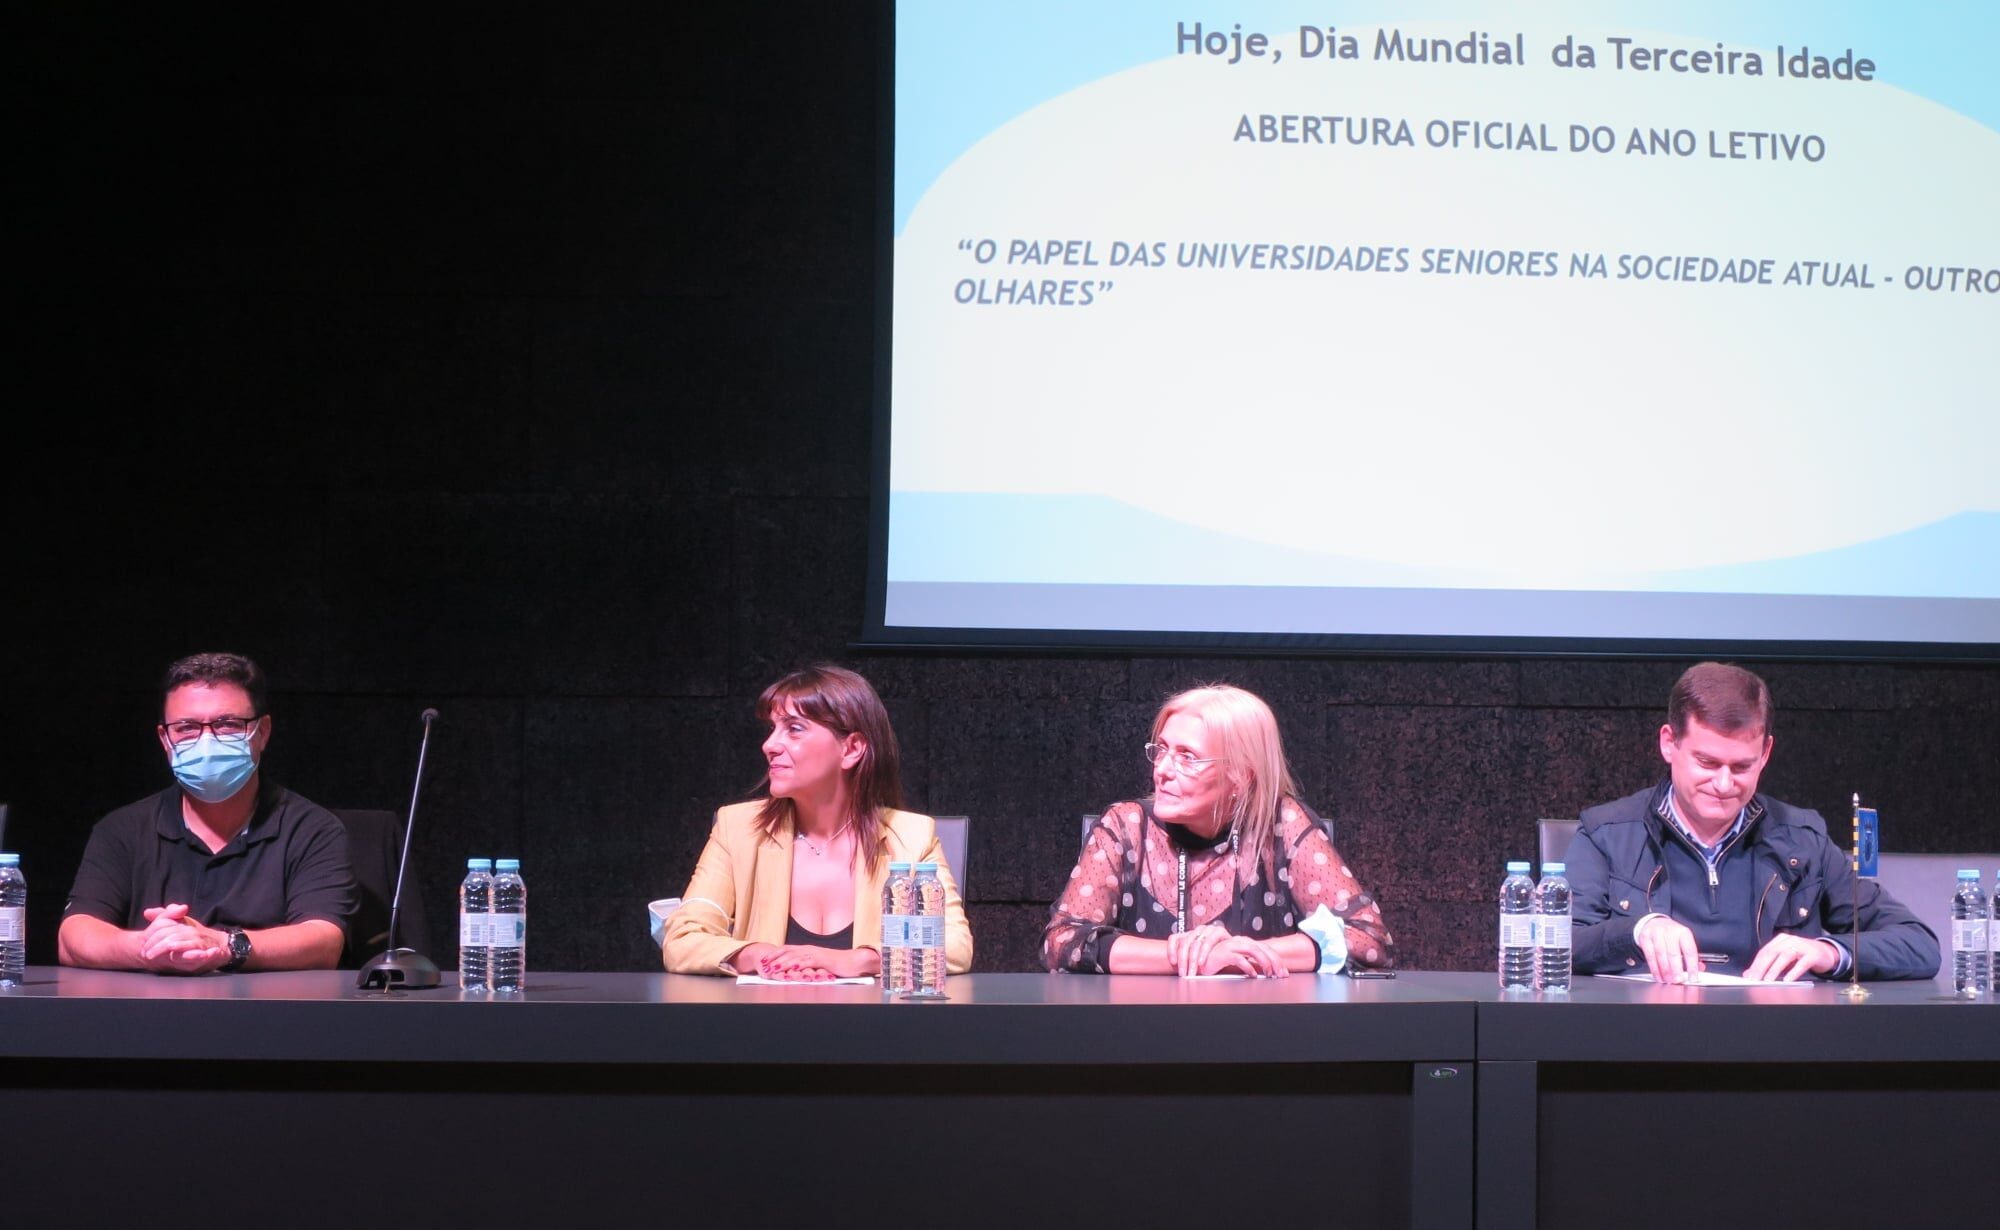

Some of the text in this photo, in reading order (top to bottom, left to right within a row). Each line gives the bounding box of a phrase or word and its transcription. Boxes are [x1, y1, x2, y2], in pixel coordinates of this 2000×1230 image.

[1177, 22, 1877, 81] Hoje, Dia Mundial da Terceira Idade
[1232, 114, 1826, 163] ABERTURA OFICIAL DO ANO LETIVO
[1008, 239, 1098, 267] PAPEL
[1110, 241, 1167, 267] DAS
[1177, 243, 1410, 273] UNIVERSIDADES
[1419, 249, 1559, 277] SENIORES
[1569, 253, 1608, 279] NA
[1616, 255, 1776, 285] SOCIEDADE
[1783, 261, 1876, 289] ATUAL
[1904, 266, 2000, 294] OUTRO
